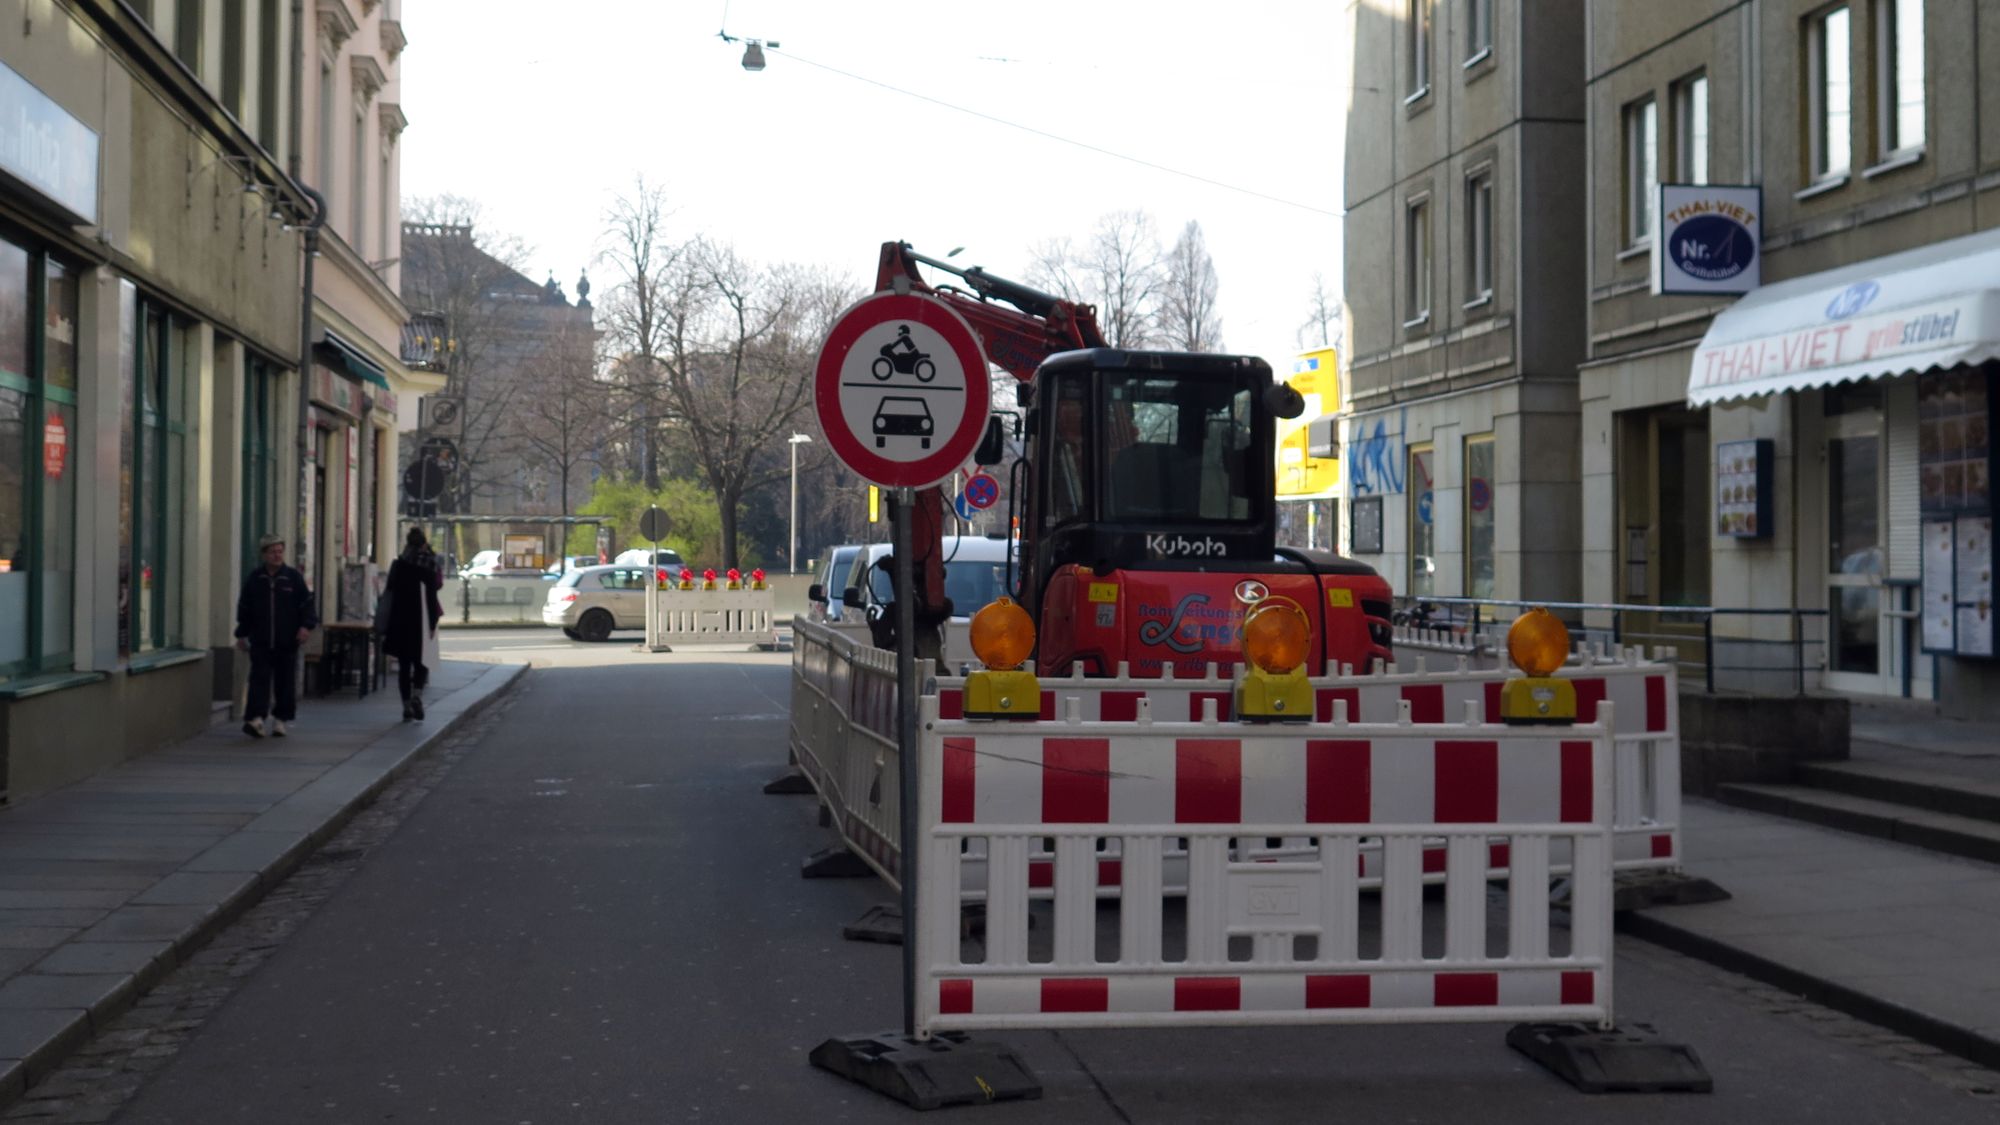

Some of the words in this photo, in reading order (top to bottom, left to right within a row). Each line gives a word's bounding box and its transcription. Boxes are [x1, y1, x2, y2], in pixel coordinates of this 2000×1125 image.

[1667, 200, 1756, 225] THAI-VIET
[1681, 238, 1711, 259] Nr.
[1704, 325, 1852, 385] THAI-VIET
[1146, 535, 1226, 556] Kubota
